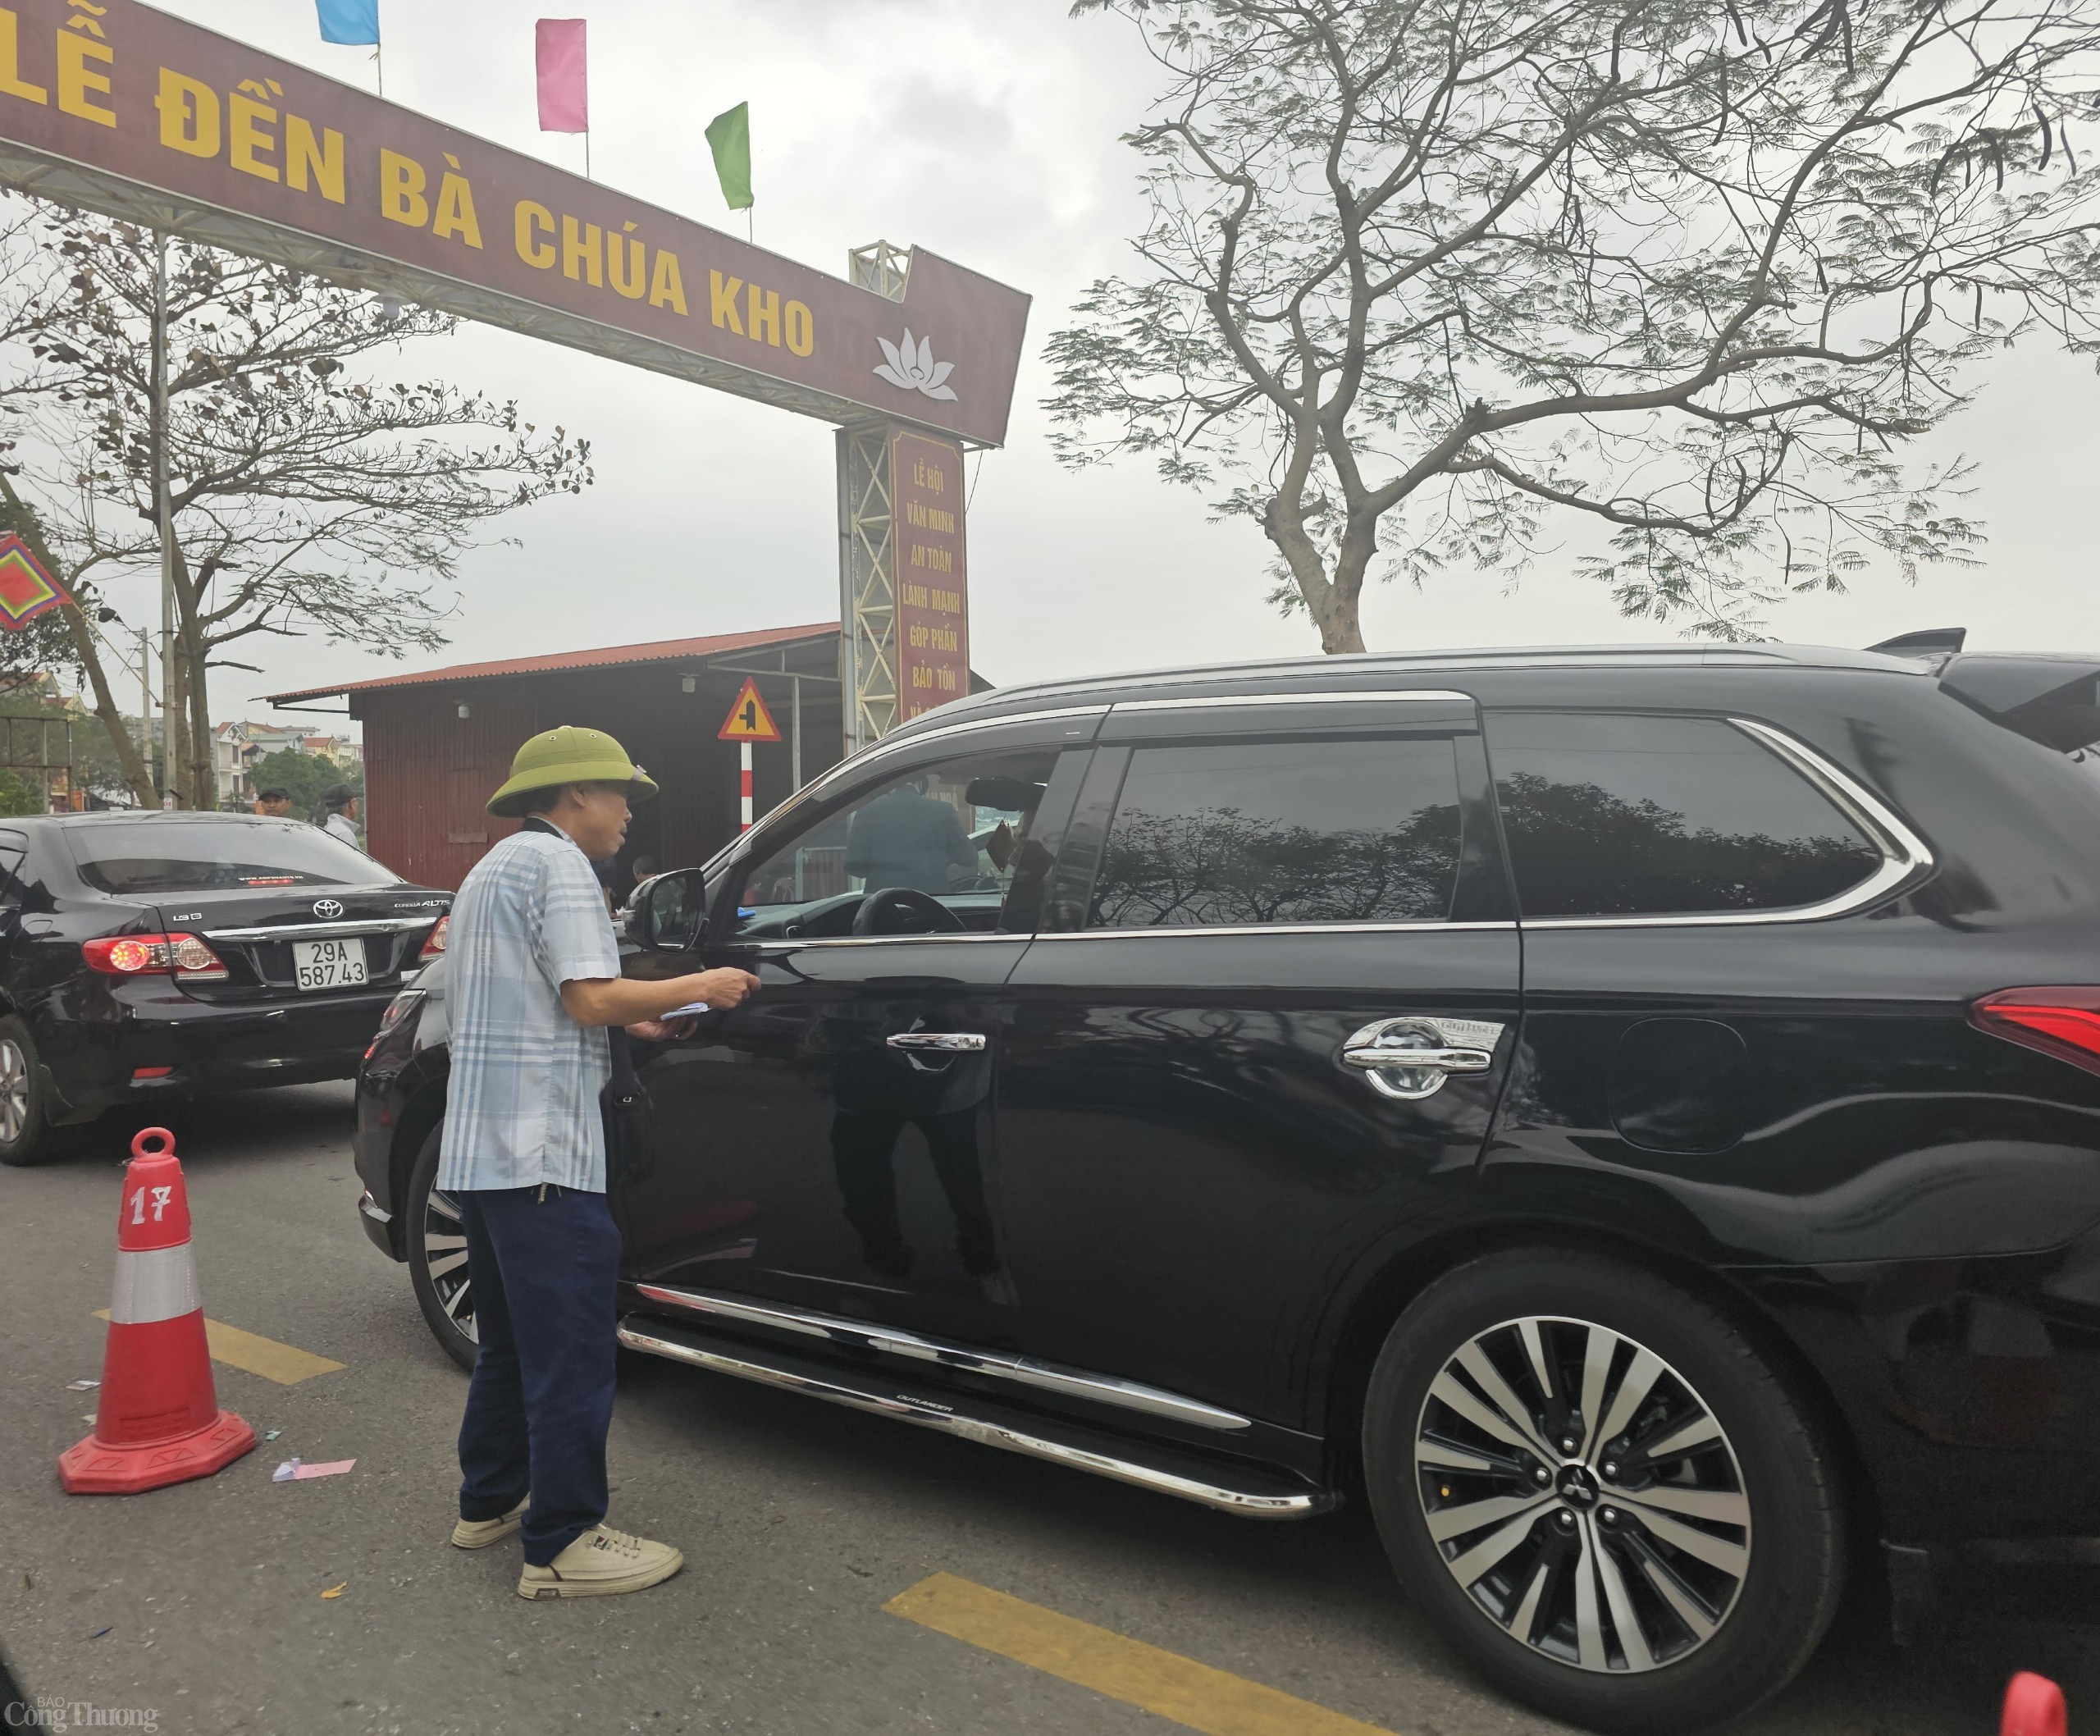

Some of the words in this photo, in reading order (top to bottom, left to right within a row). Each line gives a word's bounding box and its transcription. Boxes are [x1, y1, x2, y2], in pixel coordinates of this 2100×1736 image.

[0, 0, 116, 129] LỄ
[154, 66, 345, 204] ĐỀN
[381, 148, 483, 249] BÀ
[514, 200, 688, 317] CHÚA
[710, 269, 814, 358] KHO
[914, 458, 925, 487] LỄ
[927, 464, 944, 496] HỘI
[906, 499, 926, 528] VĂN
[929, 508, 955, 534] MINH
[911, 544, 925, 567] AN
[927, 545, 952, 573] TOÀN
[902, 579, 928, 609] LÀNH
[932, 588, 960, 616] MẠNH
[910, 621, 929, 648] GÓP
[931, 624, 957, 651] PHẦN
[912, 659, 933, 689] BẢO
[937, 662, 956, 691] TỒN
[311, 941, 348, 963] 29A
[299, 962, 364, 987] 587.43
[130, 1186, 171, 1224] 17
[896, 1395, 953, 1412] OUTLANDER
